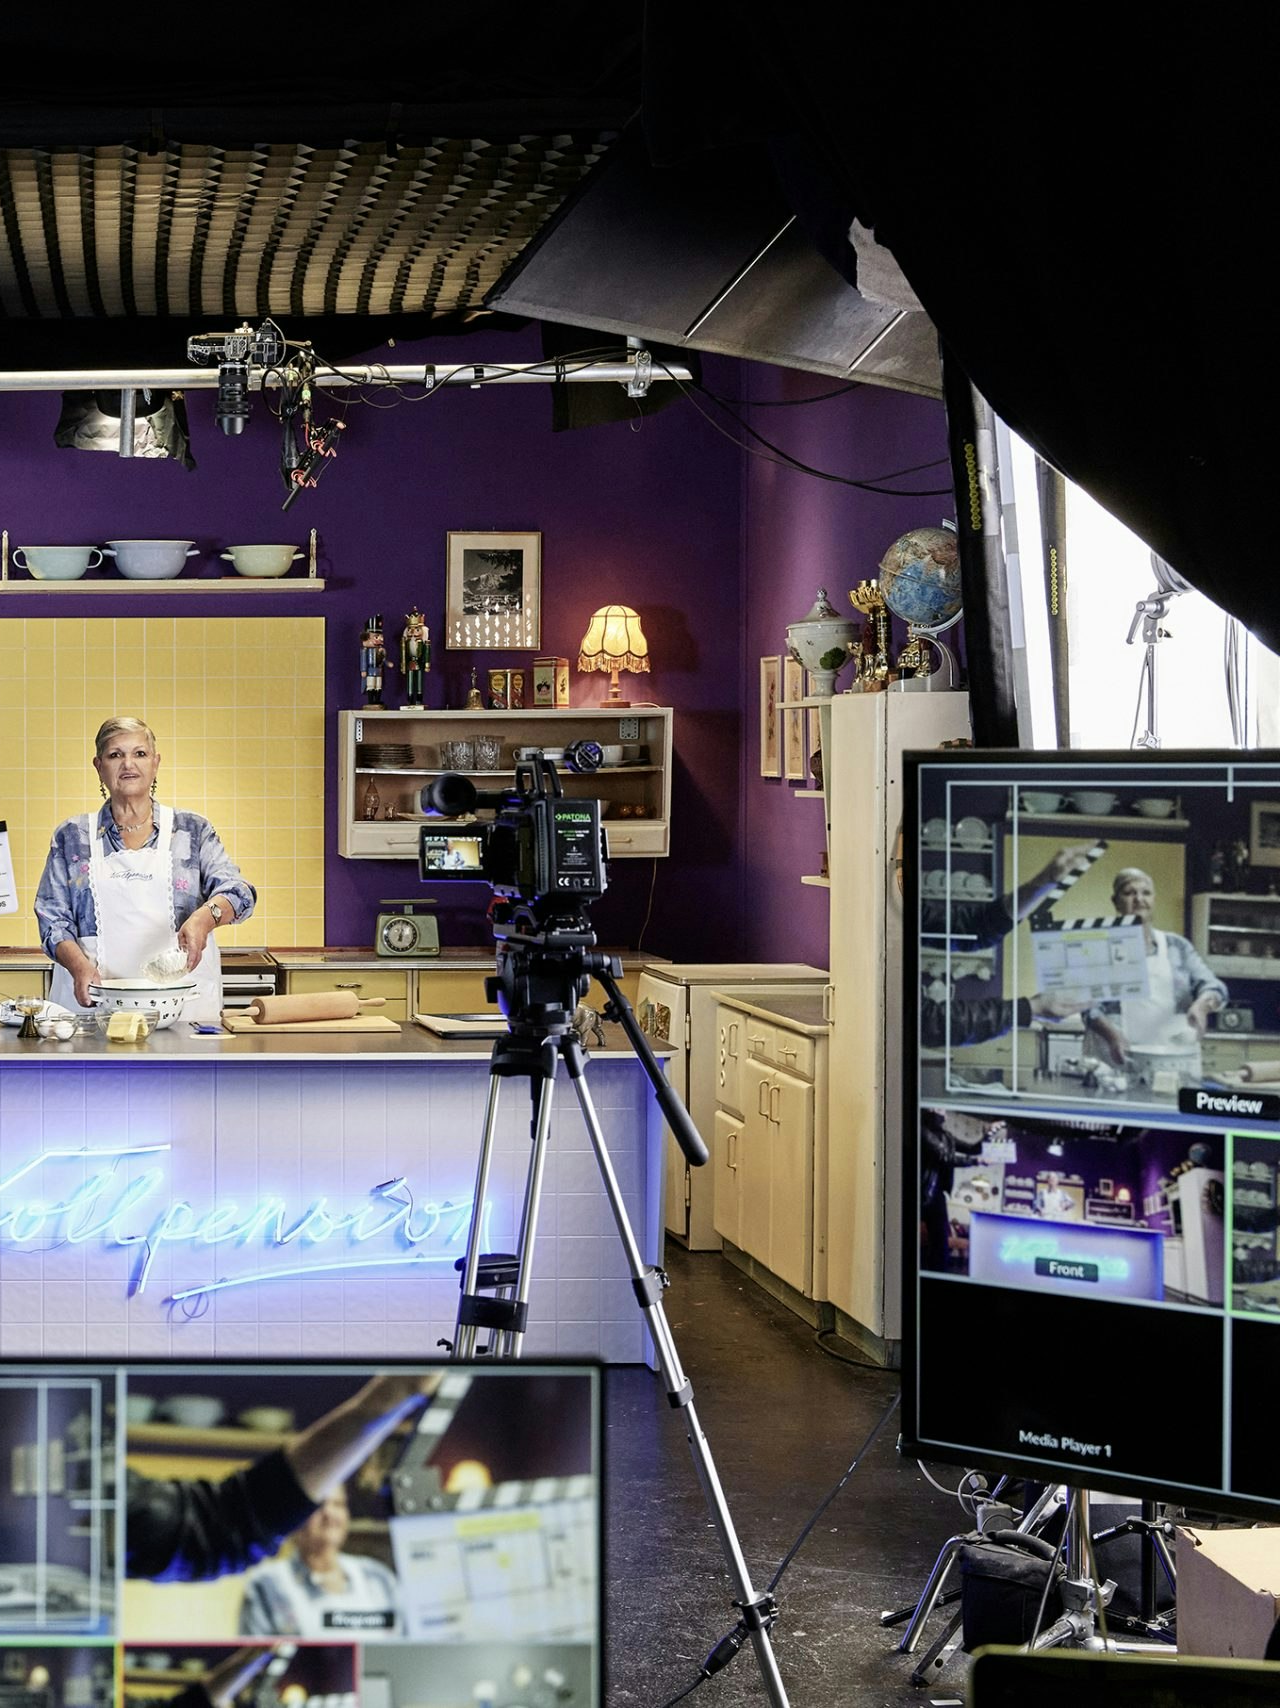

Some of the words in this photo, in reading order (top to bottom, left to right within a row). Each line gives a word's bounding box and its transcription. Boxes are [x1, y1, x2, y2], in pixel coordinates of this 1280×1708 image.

[1196, 1092, 1263, 1114] Preview
[1049, 1261, 1084, 1278] Front
[1019, 1429, 1059, 1449] Media
[1061, 1436, 1102, 1456] Player
[1104, 1444, 1112, 1458] 1
